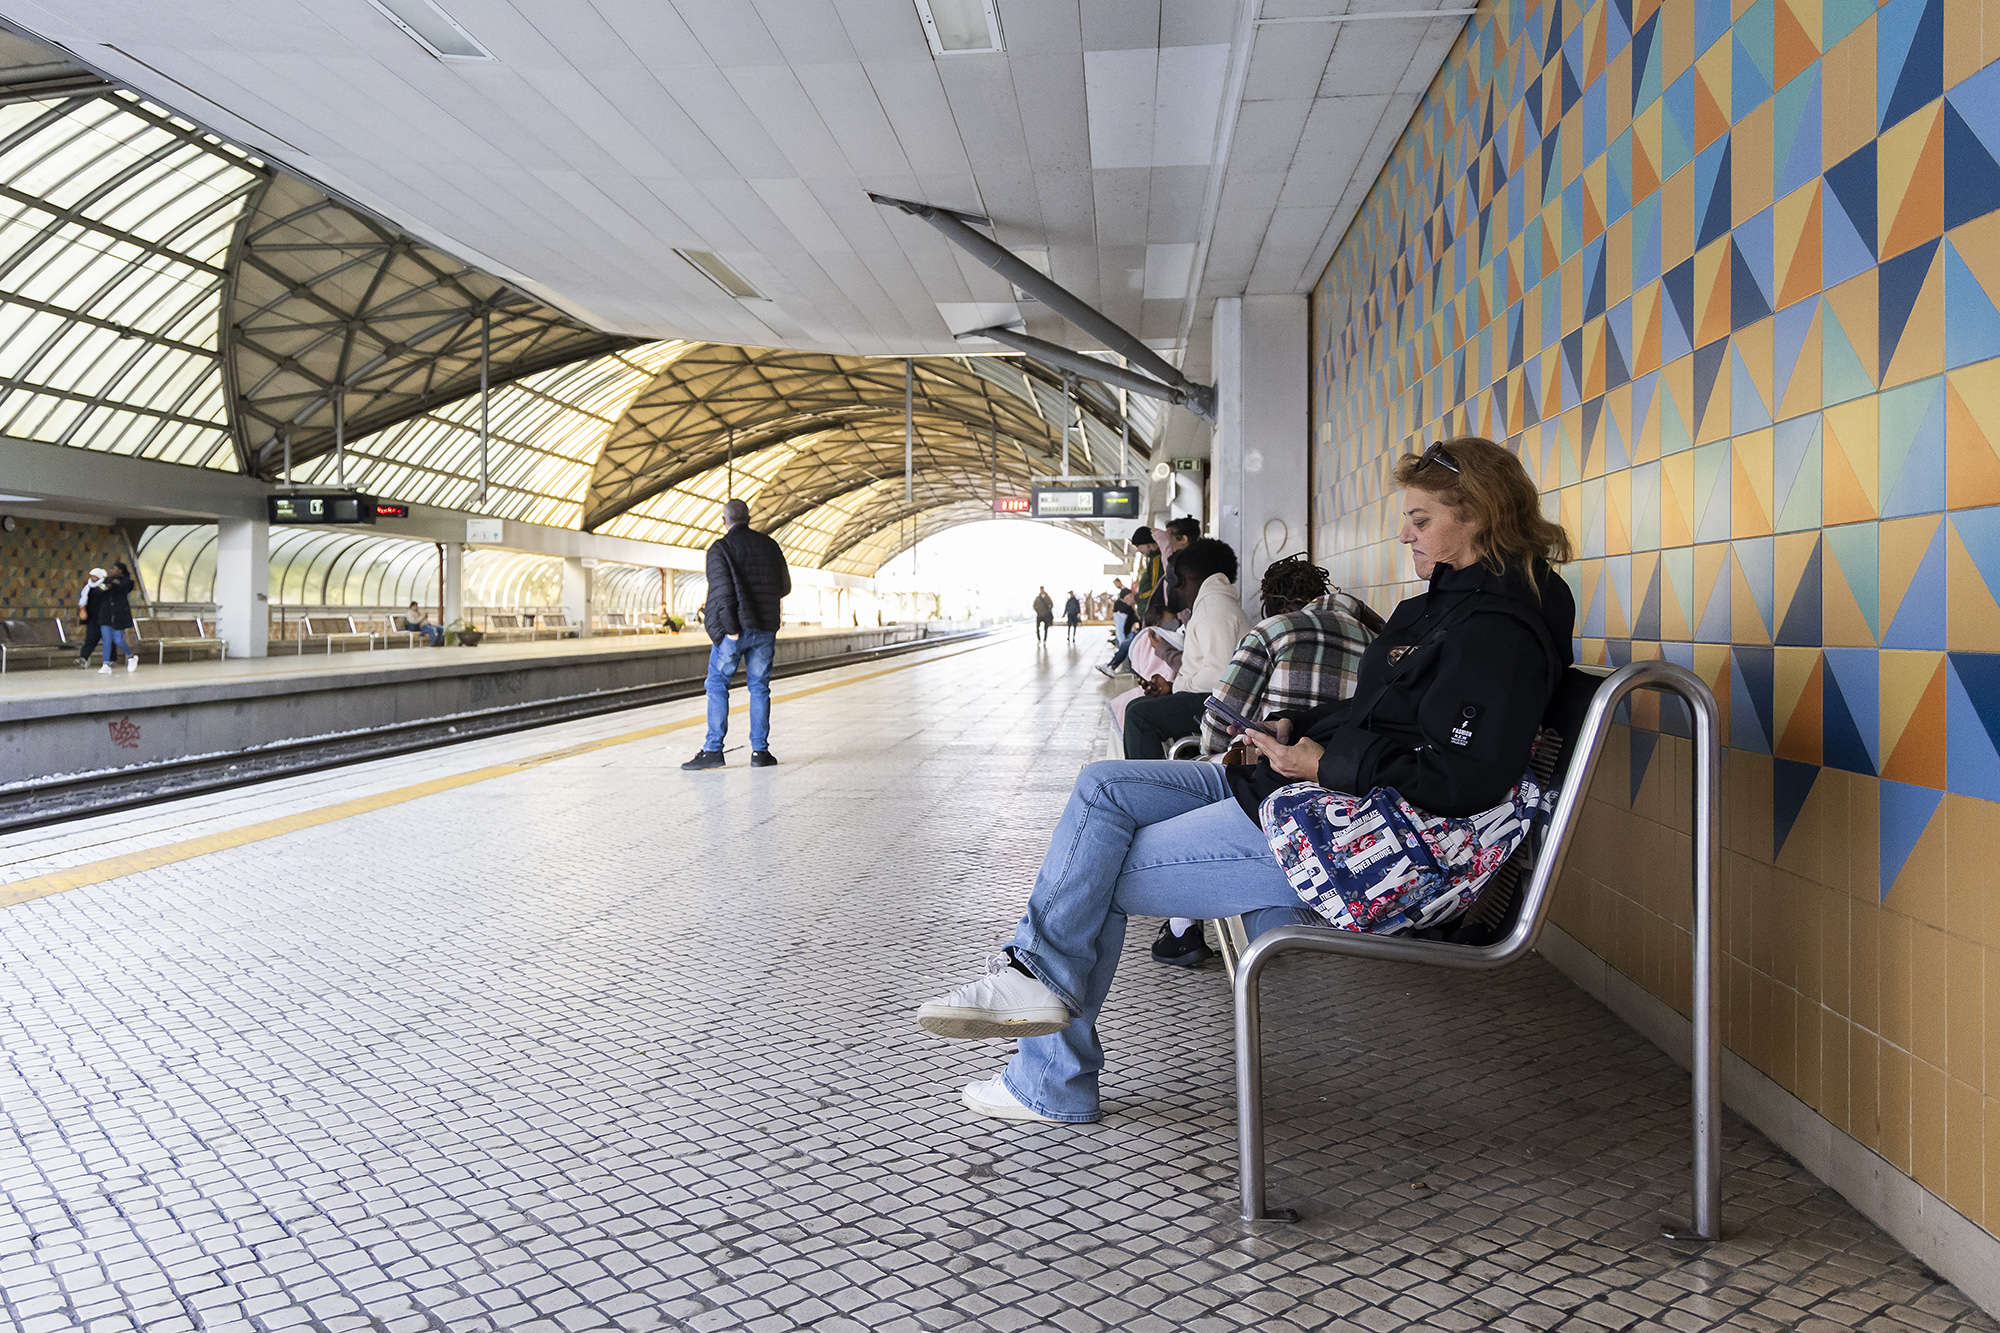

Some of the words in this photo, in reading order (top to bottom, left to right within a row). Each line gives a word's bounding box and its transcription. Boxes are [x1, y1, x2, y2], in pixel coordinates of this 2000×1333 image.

[1332, 817, 1363, 838] BUCKINGHAM
[1362, 808, 1381, 823] PALACE
[1350, 858, 1372, 875] TOWER
[1370, 846, 1392, 863] BRIDGE
